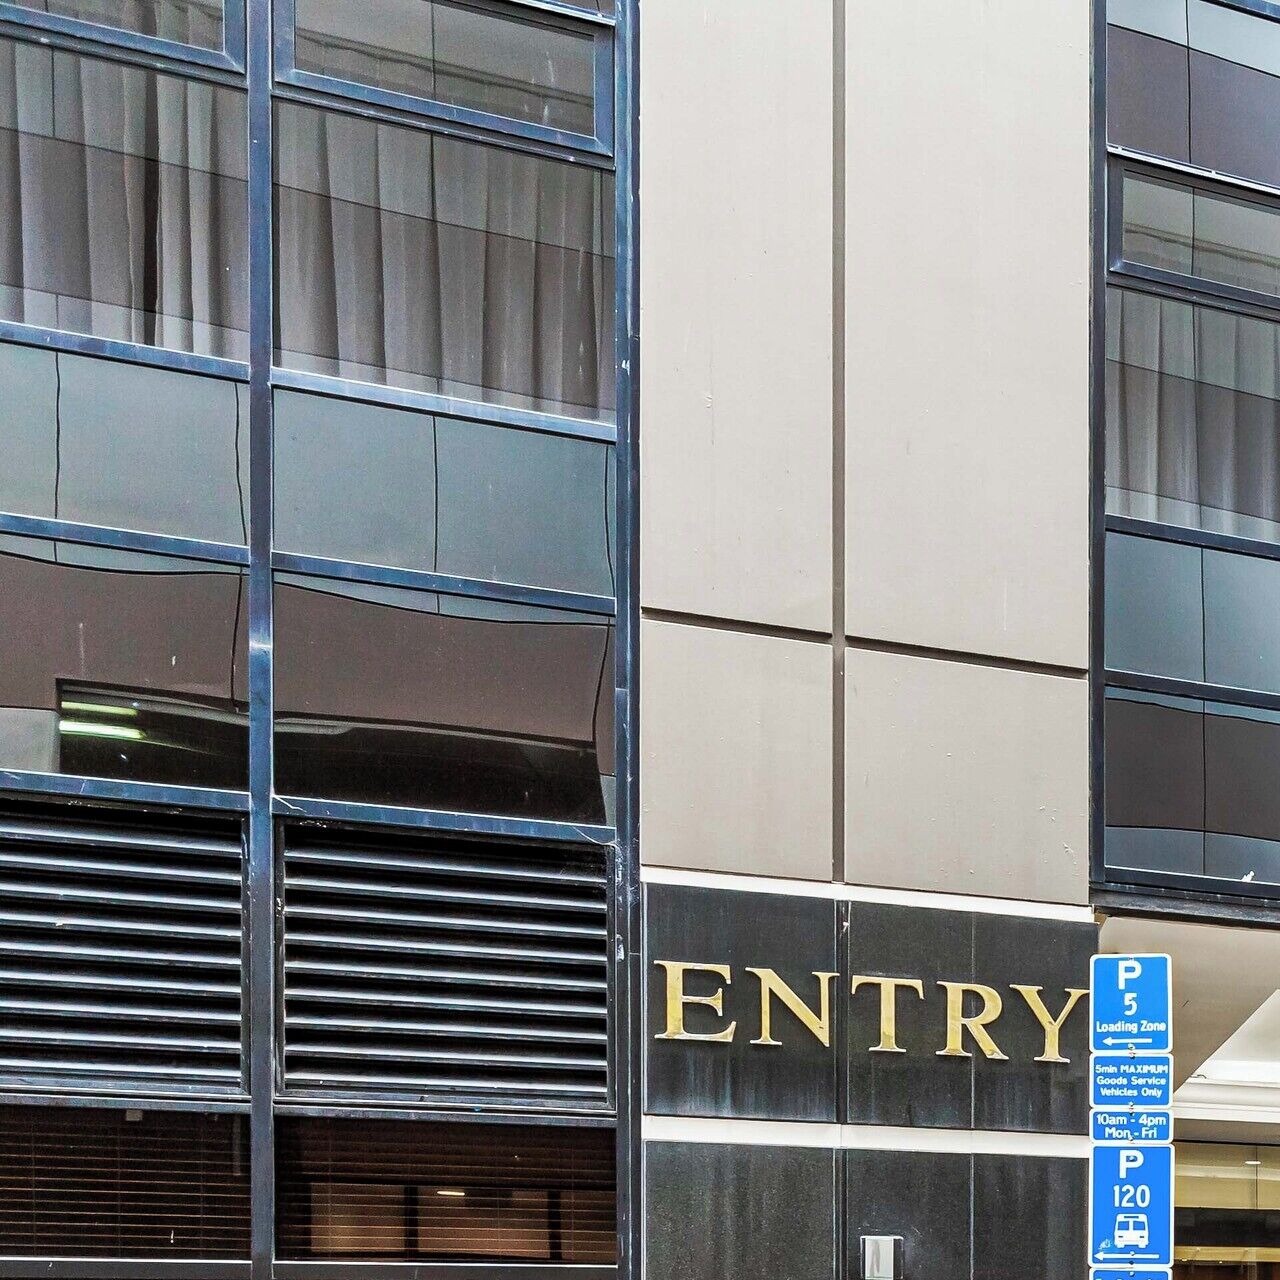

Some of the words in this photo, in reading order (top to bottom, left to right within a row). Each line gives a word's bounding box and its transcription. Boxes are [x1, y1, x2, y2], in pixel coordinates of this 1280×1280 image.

[1118, 961, 1142, 990] P
[1123, 992, 1138, 1016] 5
[654, 959, 1090, 1064] ENTRY
[1096, 1020, 1138, 1033] Loading
[1140, 1020, 1166, 1032] Zone
[1095, 1064, 1118, 1074] 5min
[1120, 1064, 1169, 1074] MAXIMUM
[1096, 1076, 1128, 1086] Goods
[1131, 1076, 1166, 1086] Service
[1100, 1087, 1138, 1097] Vehicles
[1141, 1087, 1163, 1099] Only
[1096, 1113, 1128, 1125] 10am
[1138, 1113, 1166, 1127] 4pm
[1105, 1127, 1131, 1139] Mon
[1141, 1127, 1158, 1139] Fri
[1119, 1149, 1144, 1179] P
[1113, 1184, 1151, 1208] 120
